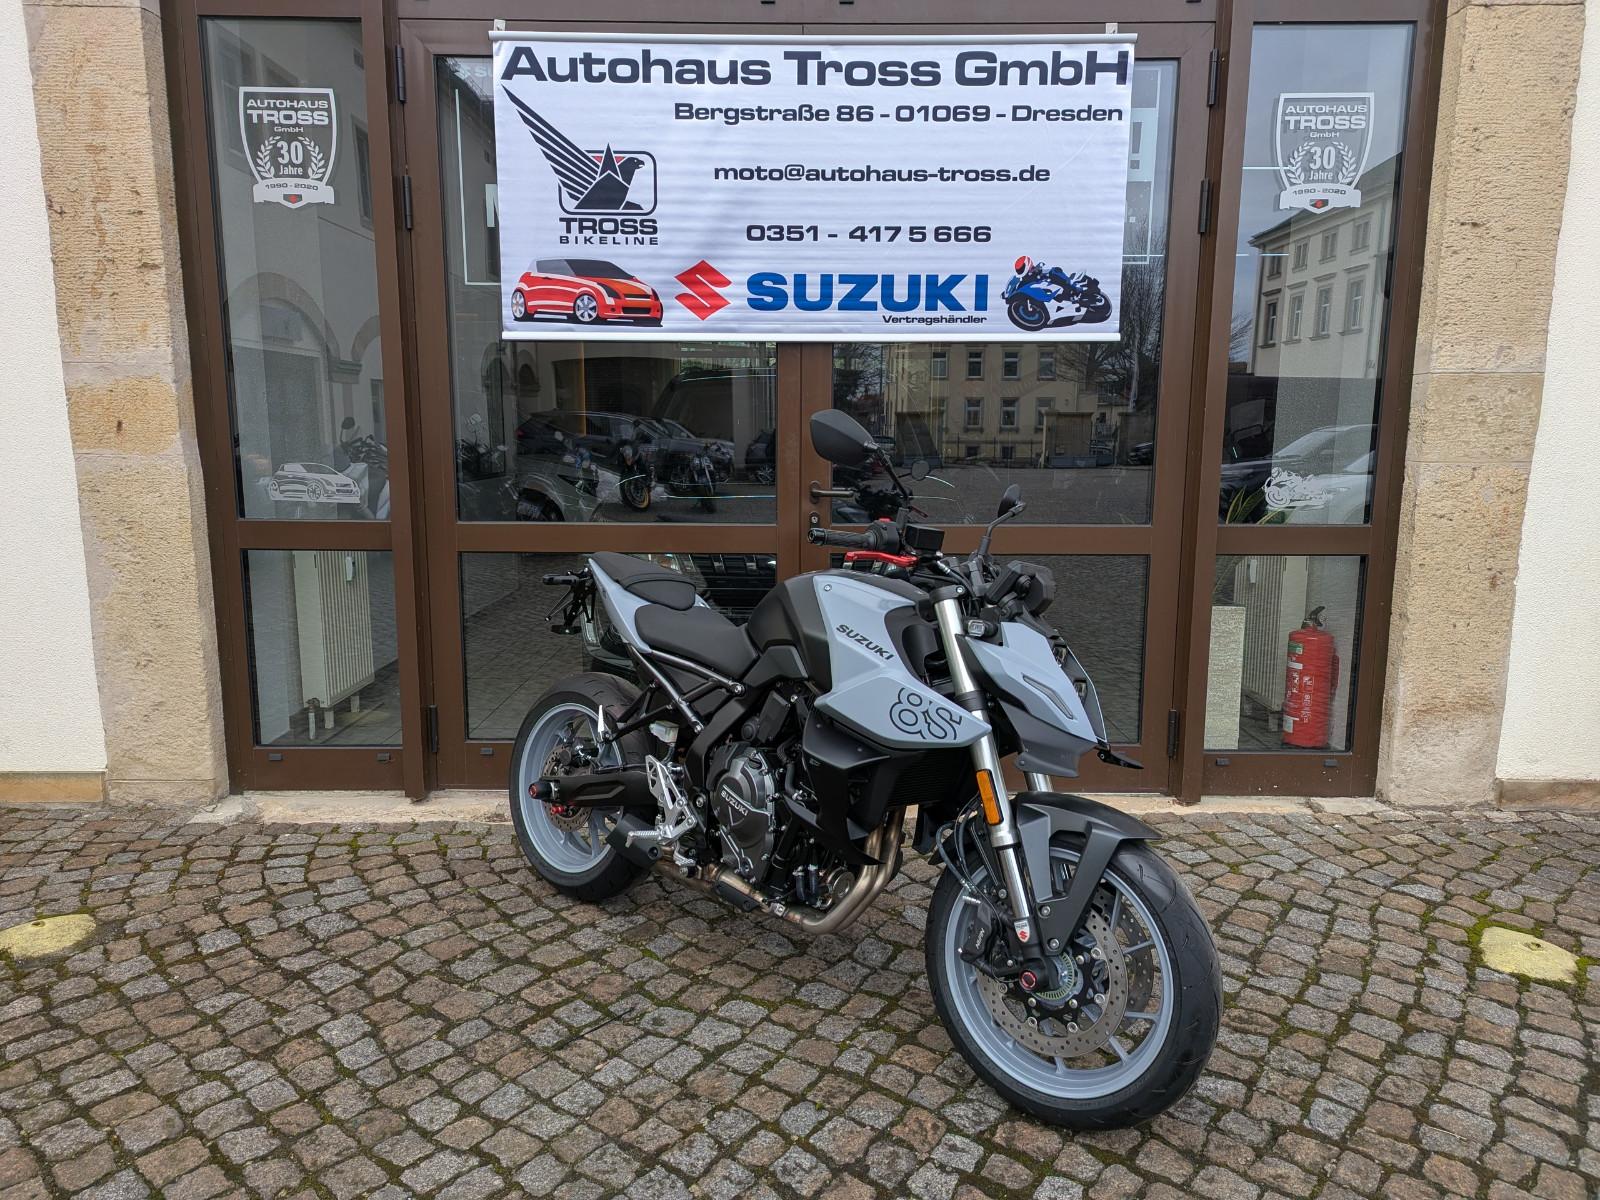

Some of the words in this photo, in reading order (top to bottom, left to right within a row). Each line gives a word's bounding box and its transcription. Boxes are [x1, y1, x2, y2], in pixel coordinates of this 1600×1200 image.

[501, 46, 771, 85] Autohaus
[784, 51, 941, 86] Tross
[955, 51, 1129, 86] GmbH
[247, 99, 328, 108] AUTOHAUS
[1286, 105, 1368, 113] AUTOHAUS
[247, 110, 328, 125] TROSS
[675, 103, 829, 125] Bergstraße
[837, 105, 874, 122] 86
[896, 105, 990, 122] 01069
[1012, 105, 1122, 121] Dresden
[1284, 116, 1366, 130] TROSS
[277, 141, 303, 164] 30
[1310, 146, 1336, 170] 30
[280, 165, 302, 174] Jahre
[715, 164, 1050, 181] moto@autohaus-tross.de
[1309, 170, 1334, 180] Jahre
[559, 218, 657, 235] TROSS
[747, 225, 818, 241] 0351
[849, 226, 901, 242] 417
[934, 226, 991, 242] 666
[560, 236, 658, 245] BIKELINE
[747, 272, 988, 311] SUZUKI
[883, 315, 987, 325] Vertragshändler
[836, 624, 894, 660] SUZUKI
[720, 790, 748, 816] SUZUKI
